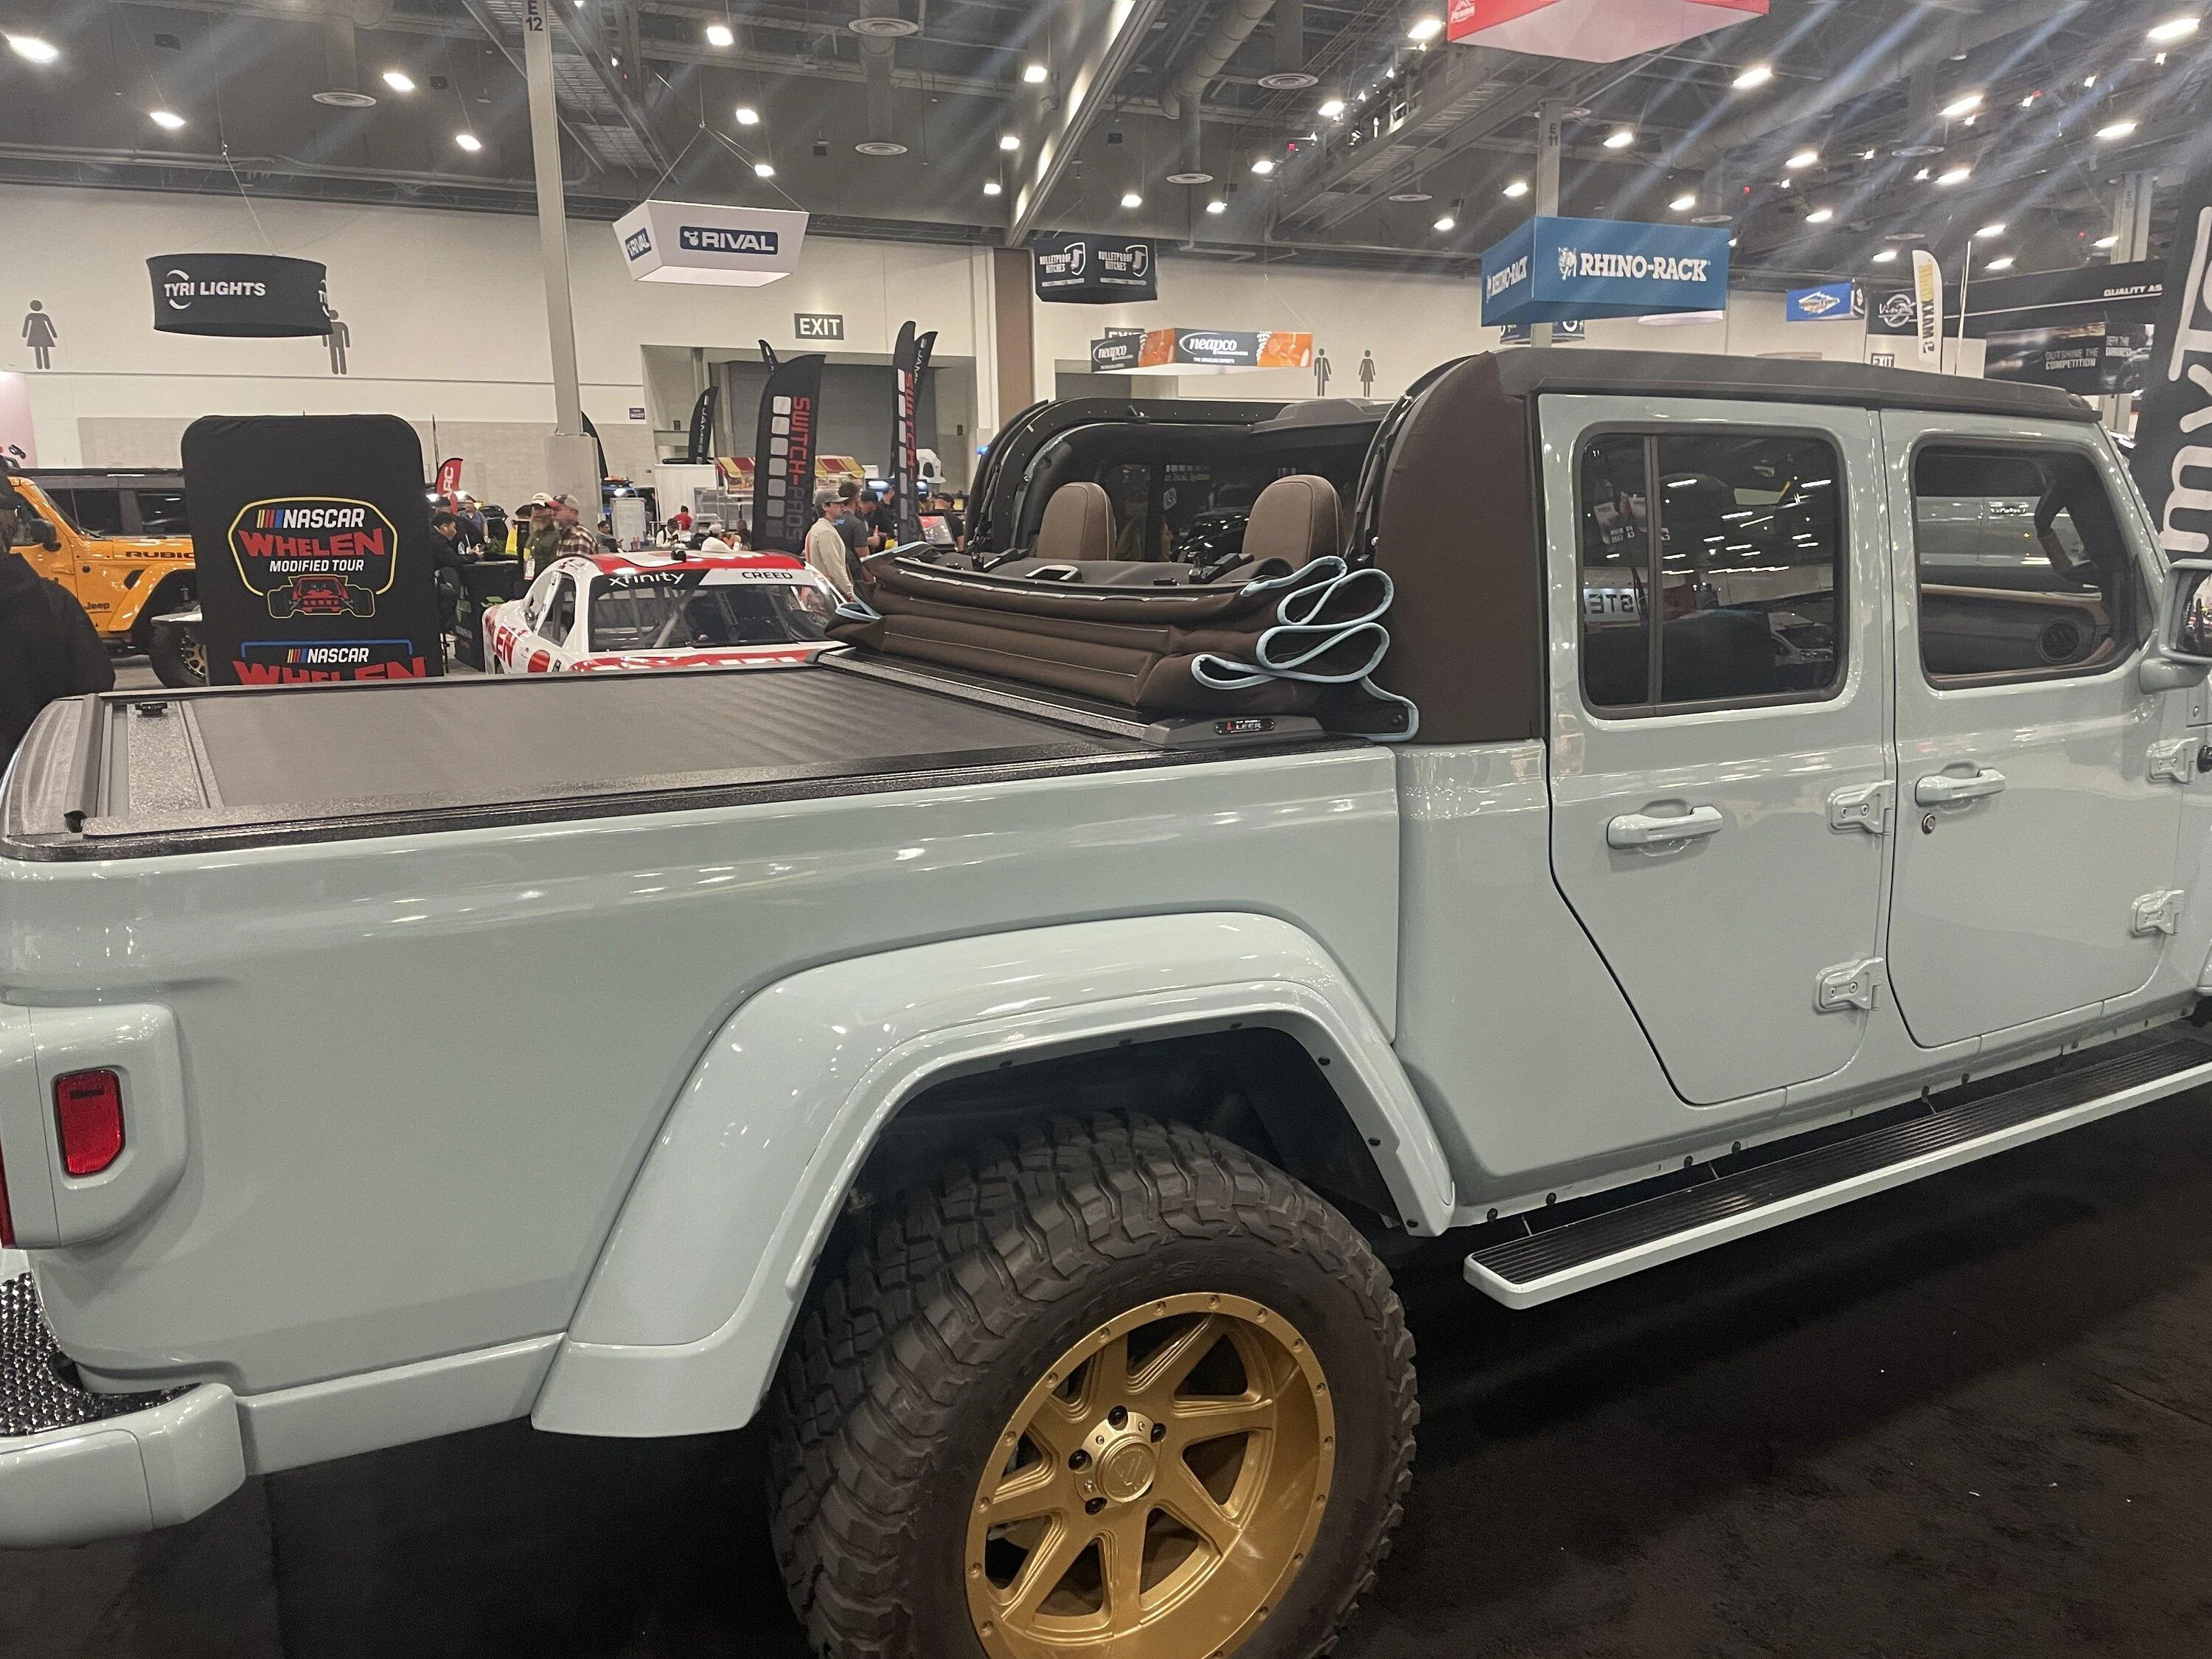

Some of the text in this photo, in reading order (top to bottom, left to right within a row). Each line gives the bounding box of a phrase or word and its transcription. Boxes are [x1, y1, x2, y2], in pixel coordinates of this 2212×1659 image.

[525, 16, 543, 31] 12
[702, 231, 774, 251] RIVAL
[1580, 252, 1708, 282] RHINO-RACK
[164, 282, 266, 296] TYRI LIGHTS
[2104, 285, 2146, 296] QUALITY
[799, 317, 841, 336] EXIT
[1098, 344, 1127, 361] neapco
[1189, 338, 1238, 355] neapco
[1873, 355, 1893, 367] EXIT
[283, 508, 365, 529] NASCAR
[237, 528, 385, 557] WHELEN
[269, 559, 364, 572] MODIFIED TOUR
[608, 571, 684, 588] xfinity
[742, 571, 793, 580] CREED
[84, 602, 110, 611] Jeep
[307, 647, 369, 663] NASCAR
